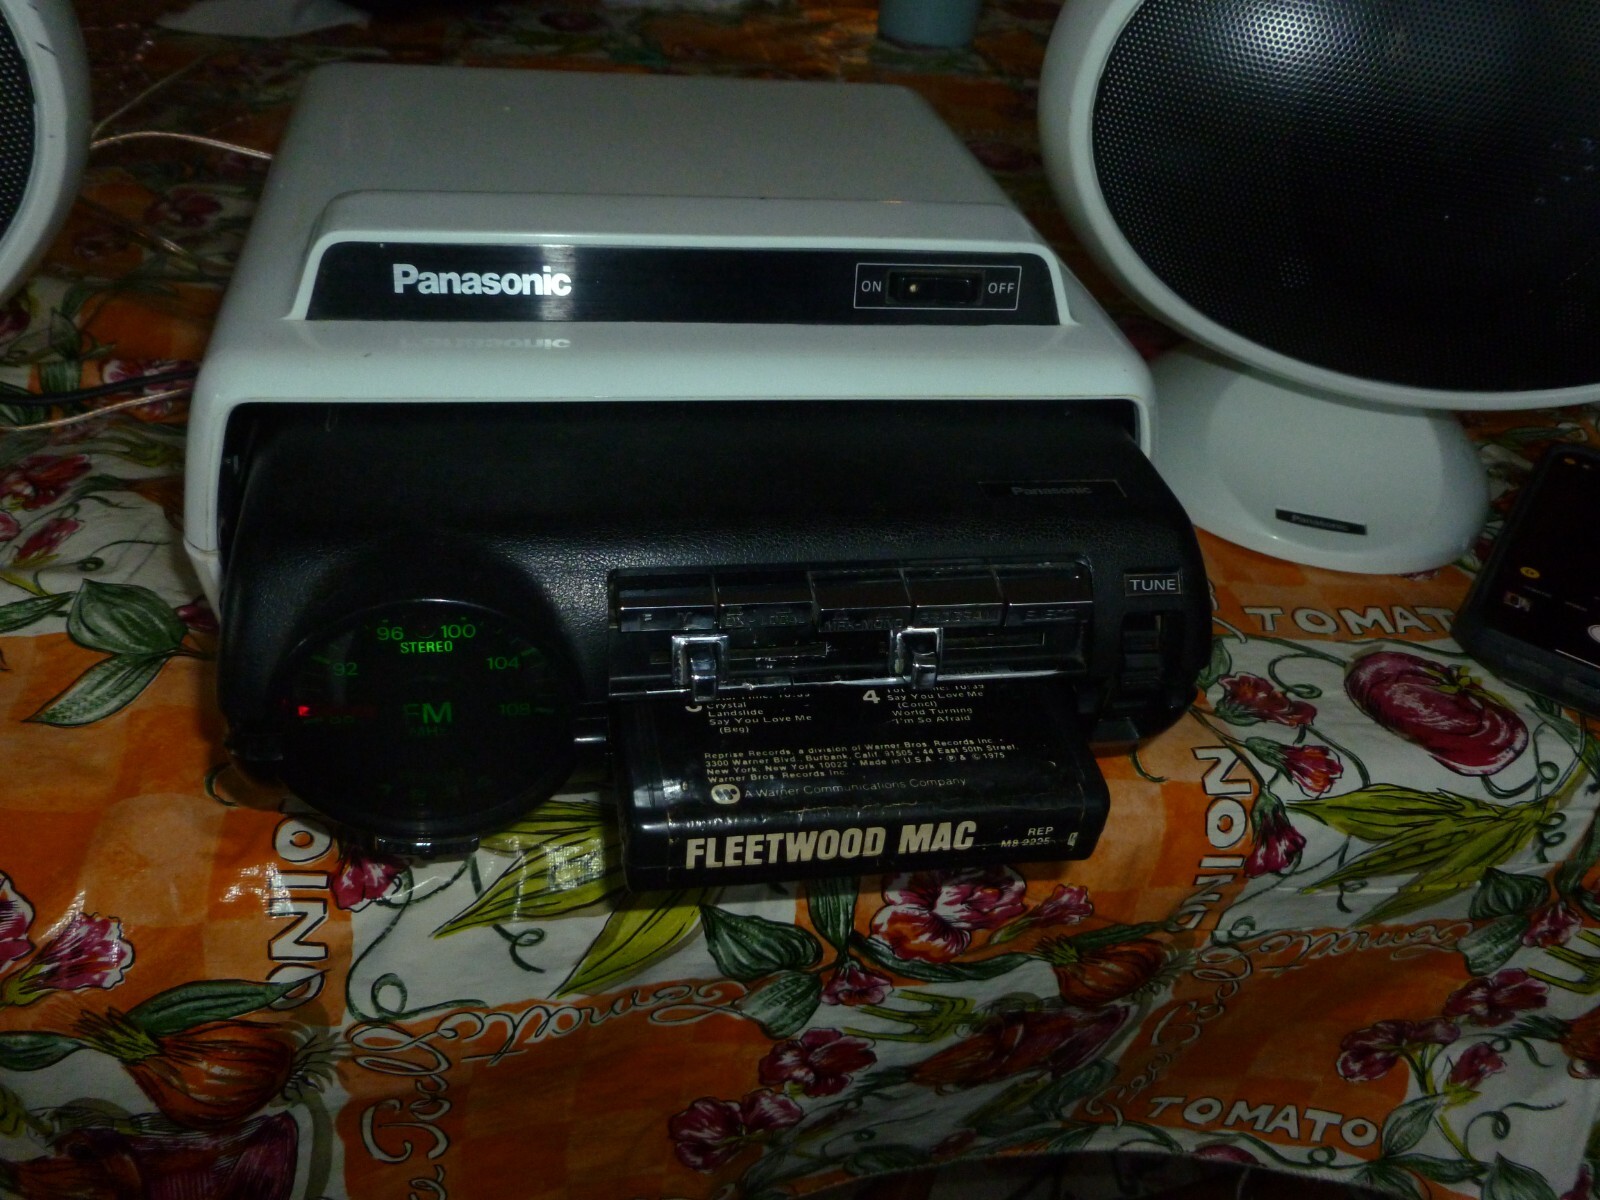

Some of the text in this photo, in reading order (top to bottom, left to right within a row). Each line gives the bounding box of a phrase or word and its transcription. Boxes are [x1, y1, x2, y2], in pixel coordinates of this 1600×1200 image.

[392, 263, 572, 297] Panasonic
[861, 280, 882, 293] ON
[987, 282, 1015, 295] OFF
[1129, 578, 1177, 592] TUNE
[1243, 605, 1457, 635] TOMAT
[376, 626, 405, 641] 96
[438, 624, 477, 640] 100
[399, 640, 454, 655] STEREO
[332, 662, 360, 678] 92
[486, 656, 522, 671] 104
[862, 689, 881, 704] 4
[886, 690, 984, 702] Say You Love Me
[404, 701, 454, 724] FM
[708, 708, 764, 718] Landslide
[891, 706, 973, 717] World Turning
[917, 716, 932, 724] So
[936, 714, 971, 723] Afraid
[709, 717, 730, 726] Say
[734, 716, 759, 724] You
[763, 715, 791, 723] Love
[719, 726, 750, 735] (Beg)
[704, 752, 744, 761] Reprise
[808, 746, 848, 754] division
[864, 742, 900, 750] Warner
[933, 738, 974, 747] Records
[705, 760, 729, 768] 3300
[732, 758, 769, 767] Warner
[937, 746, 959, 754] East
[962, 745, 983, 753] 50th
[706, 767, 729, 776] New
[765, 764, 787, 773] New
[791, 762, 815, 771] York
[818, 760, 848, 769] 10022
[859, 758, 887, 767] Made
[891, 757, 901, 765] in
[707, 774, 745, 784] Warner
[781, 770, 825, 779] Records
[744, 776, 967, 798] A Warner Communications Company
[1027, 826, 1054, 836] REP
[685, 820, 978, 871] FLEETWOOD MAC
[1147, 1094, 1380, 1149] TOMATO
